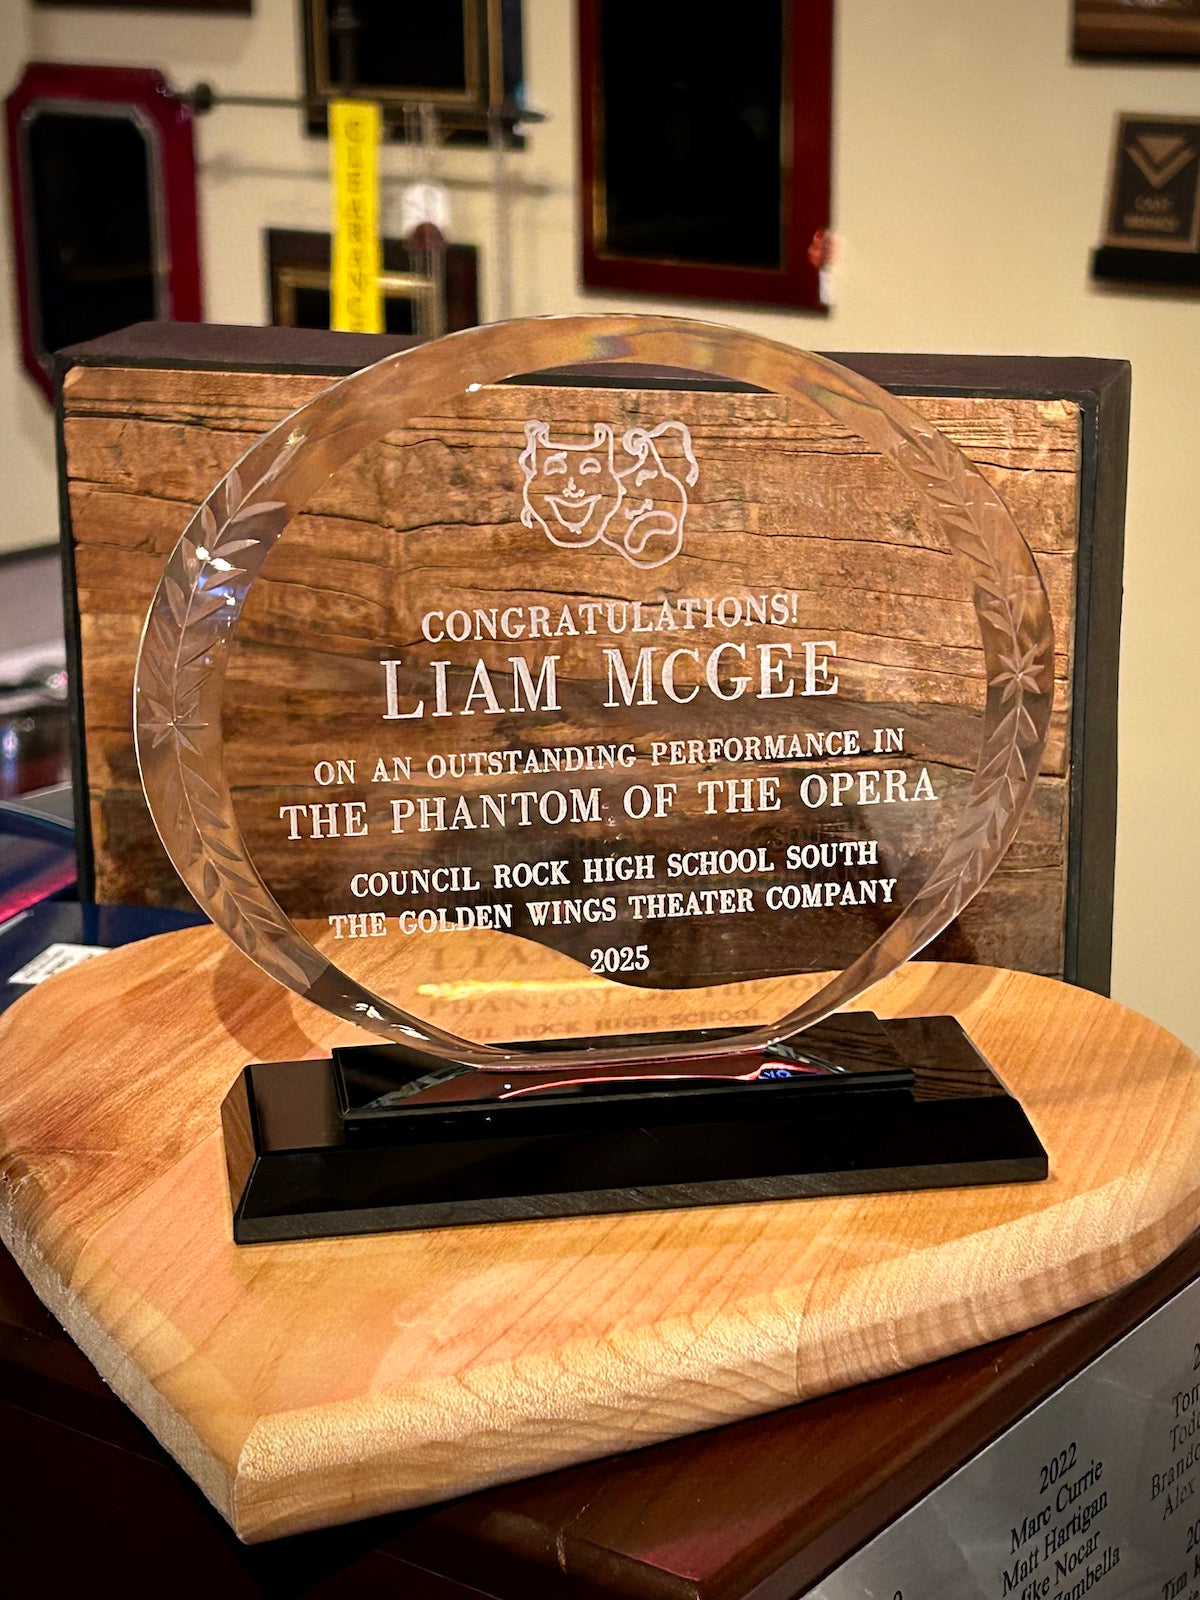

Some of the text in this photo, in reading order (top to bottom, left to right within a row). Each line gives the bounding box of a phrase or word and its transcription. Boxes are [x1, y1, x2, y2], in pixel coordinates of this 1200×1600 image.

[421, 593, 798, 643] CONGRATULATIONS!
[380, 640, 839, 719] LIAM MCGEE
[314, 728, 904, 785] ON AN OUTSTANDING PERFORMANCE IN
[279, 767, 938, 840] THE PHANTOM OF THE OPERA
[350, 840, 878, 898] COUNCIL ROCK HIGH SCHOOL SOUTH
[328, 878, 897, 939] THE GOLDEN WINGS THEATER COMPANY
[589, 945, 650, 973] 2025
[1039, 1441, 1077, 1494] 2022
[1010, 1459, 1103, 1555] Marc Currie
[1162, 1477, 1196, 1521] Alex
[1002, 1490, 1108, 1598] Matt Hartigan
[1020, 1531, 1100, 1600] ike Nocar
